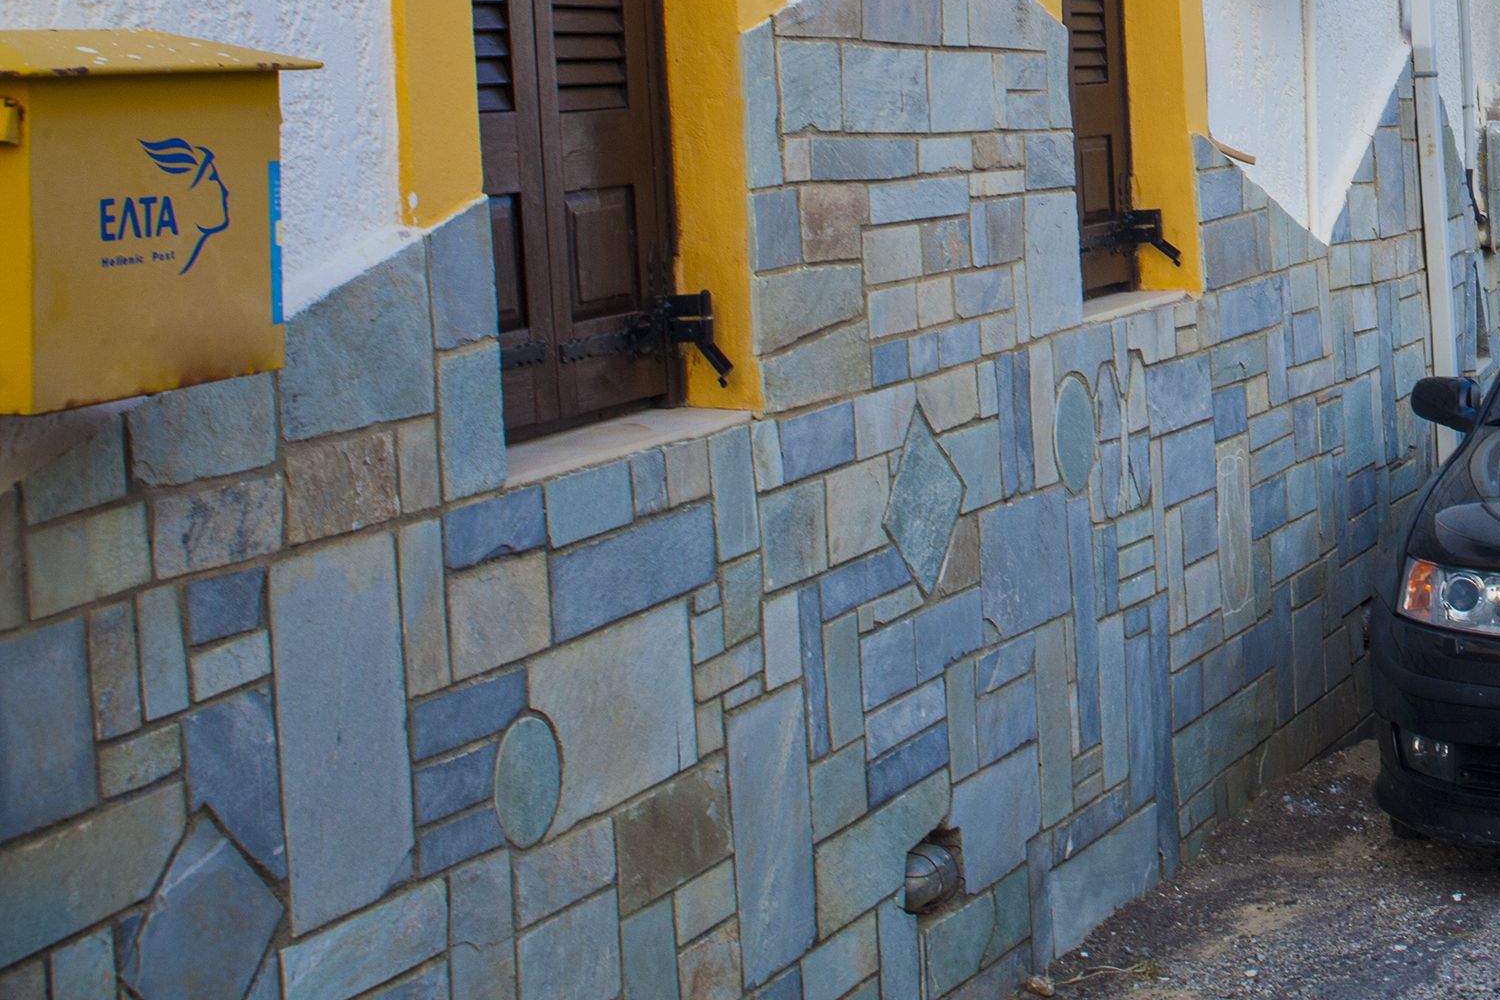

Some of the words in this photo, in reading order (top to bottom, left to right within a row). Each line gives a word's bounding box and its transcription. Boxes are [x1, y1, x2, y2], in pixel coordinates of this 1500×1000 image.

[100, 195, 179, 242] ΕΛΤΑ
[101, 255, 145, 269] Hellenic
[152, 250, 176, 262] Post
